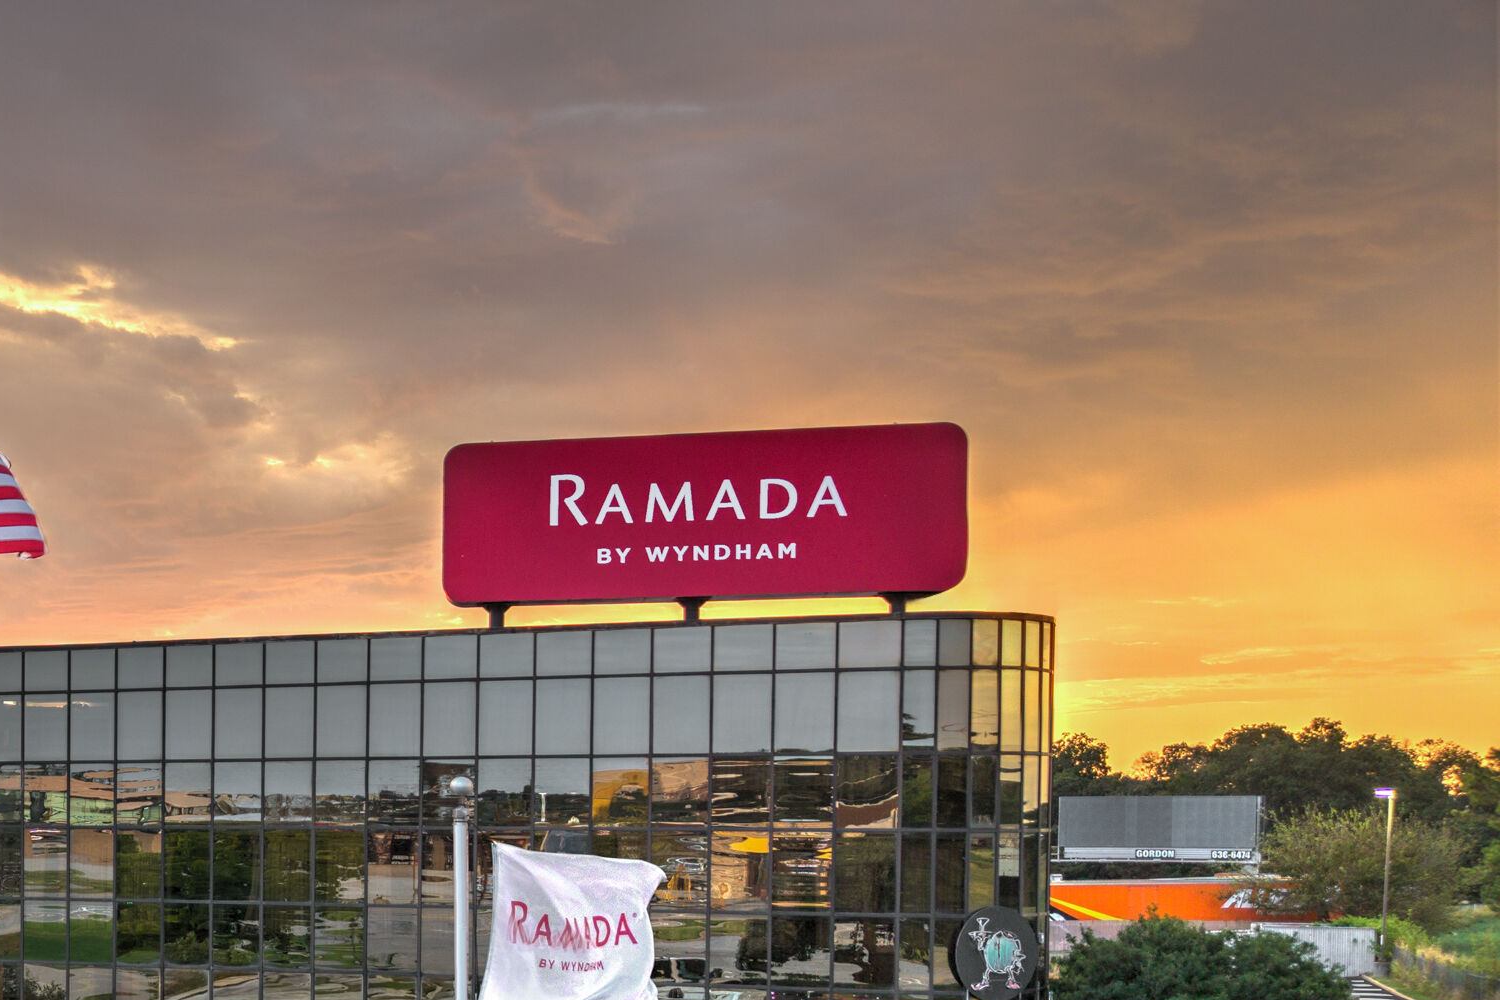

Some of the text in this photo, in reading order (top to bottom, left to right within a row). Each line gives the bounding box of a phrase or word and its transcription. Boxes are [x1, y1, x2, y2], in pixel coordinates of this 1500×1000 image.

[549, 473, 848, 526] RAMADA
[596, 542, 798, 564] BY WYNDHAM
[1135, 850, 1175, 859] GORDON
[538, 958, 556, 970] BY
